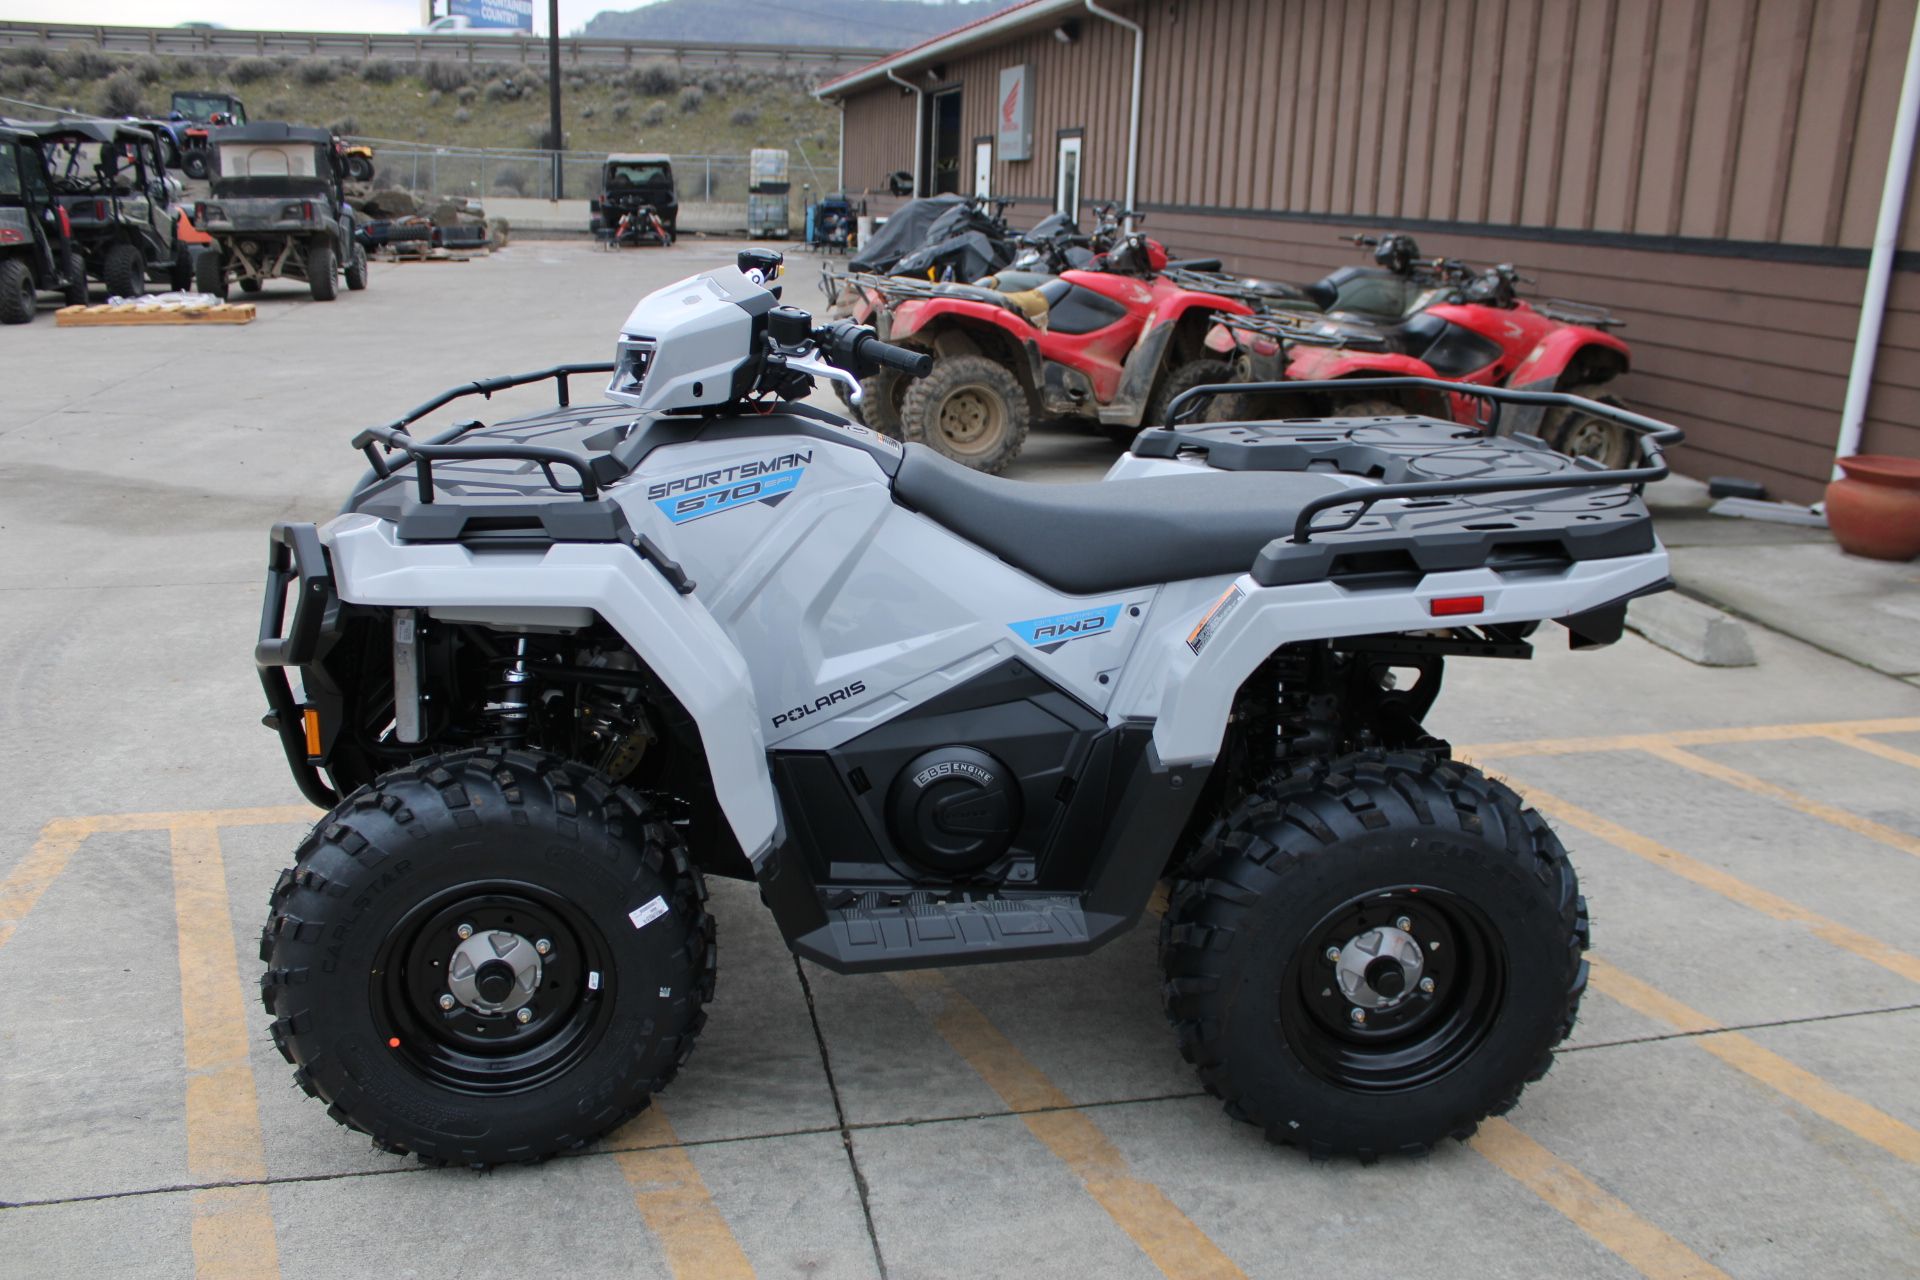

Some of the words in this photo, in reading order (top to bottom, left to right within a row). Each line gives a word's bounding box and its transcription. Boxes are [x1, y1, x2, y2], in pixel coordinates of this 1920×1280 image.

[648, 450, 813, 501] SPORTSMAN
[676, 481, 762, 515] 570
[1033, 616, 1105, 640] AWD
[771, 680, 866, 729] POLARIS
[917, 763, 950, 785] EBS
[953, 763, 991, 782] ENGINE
